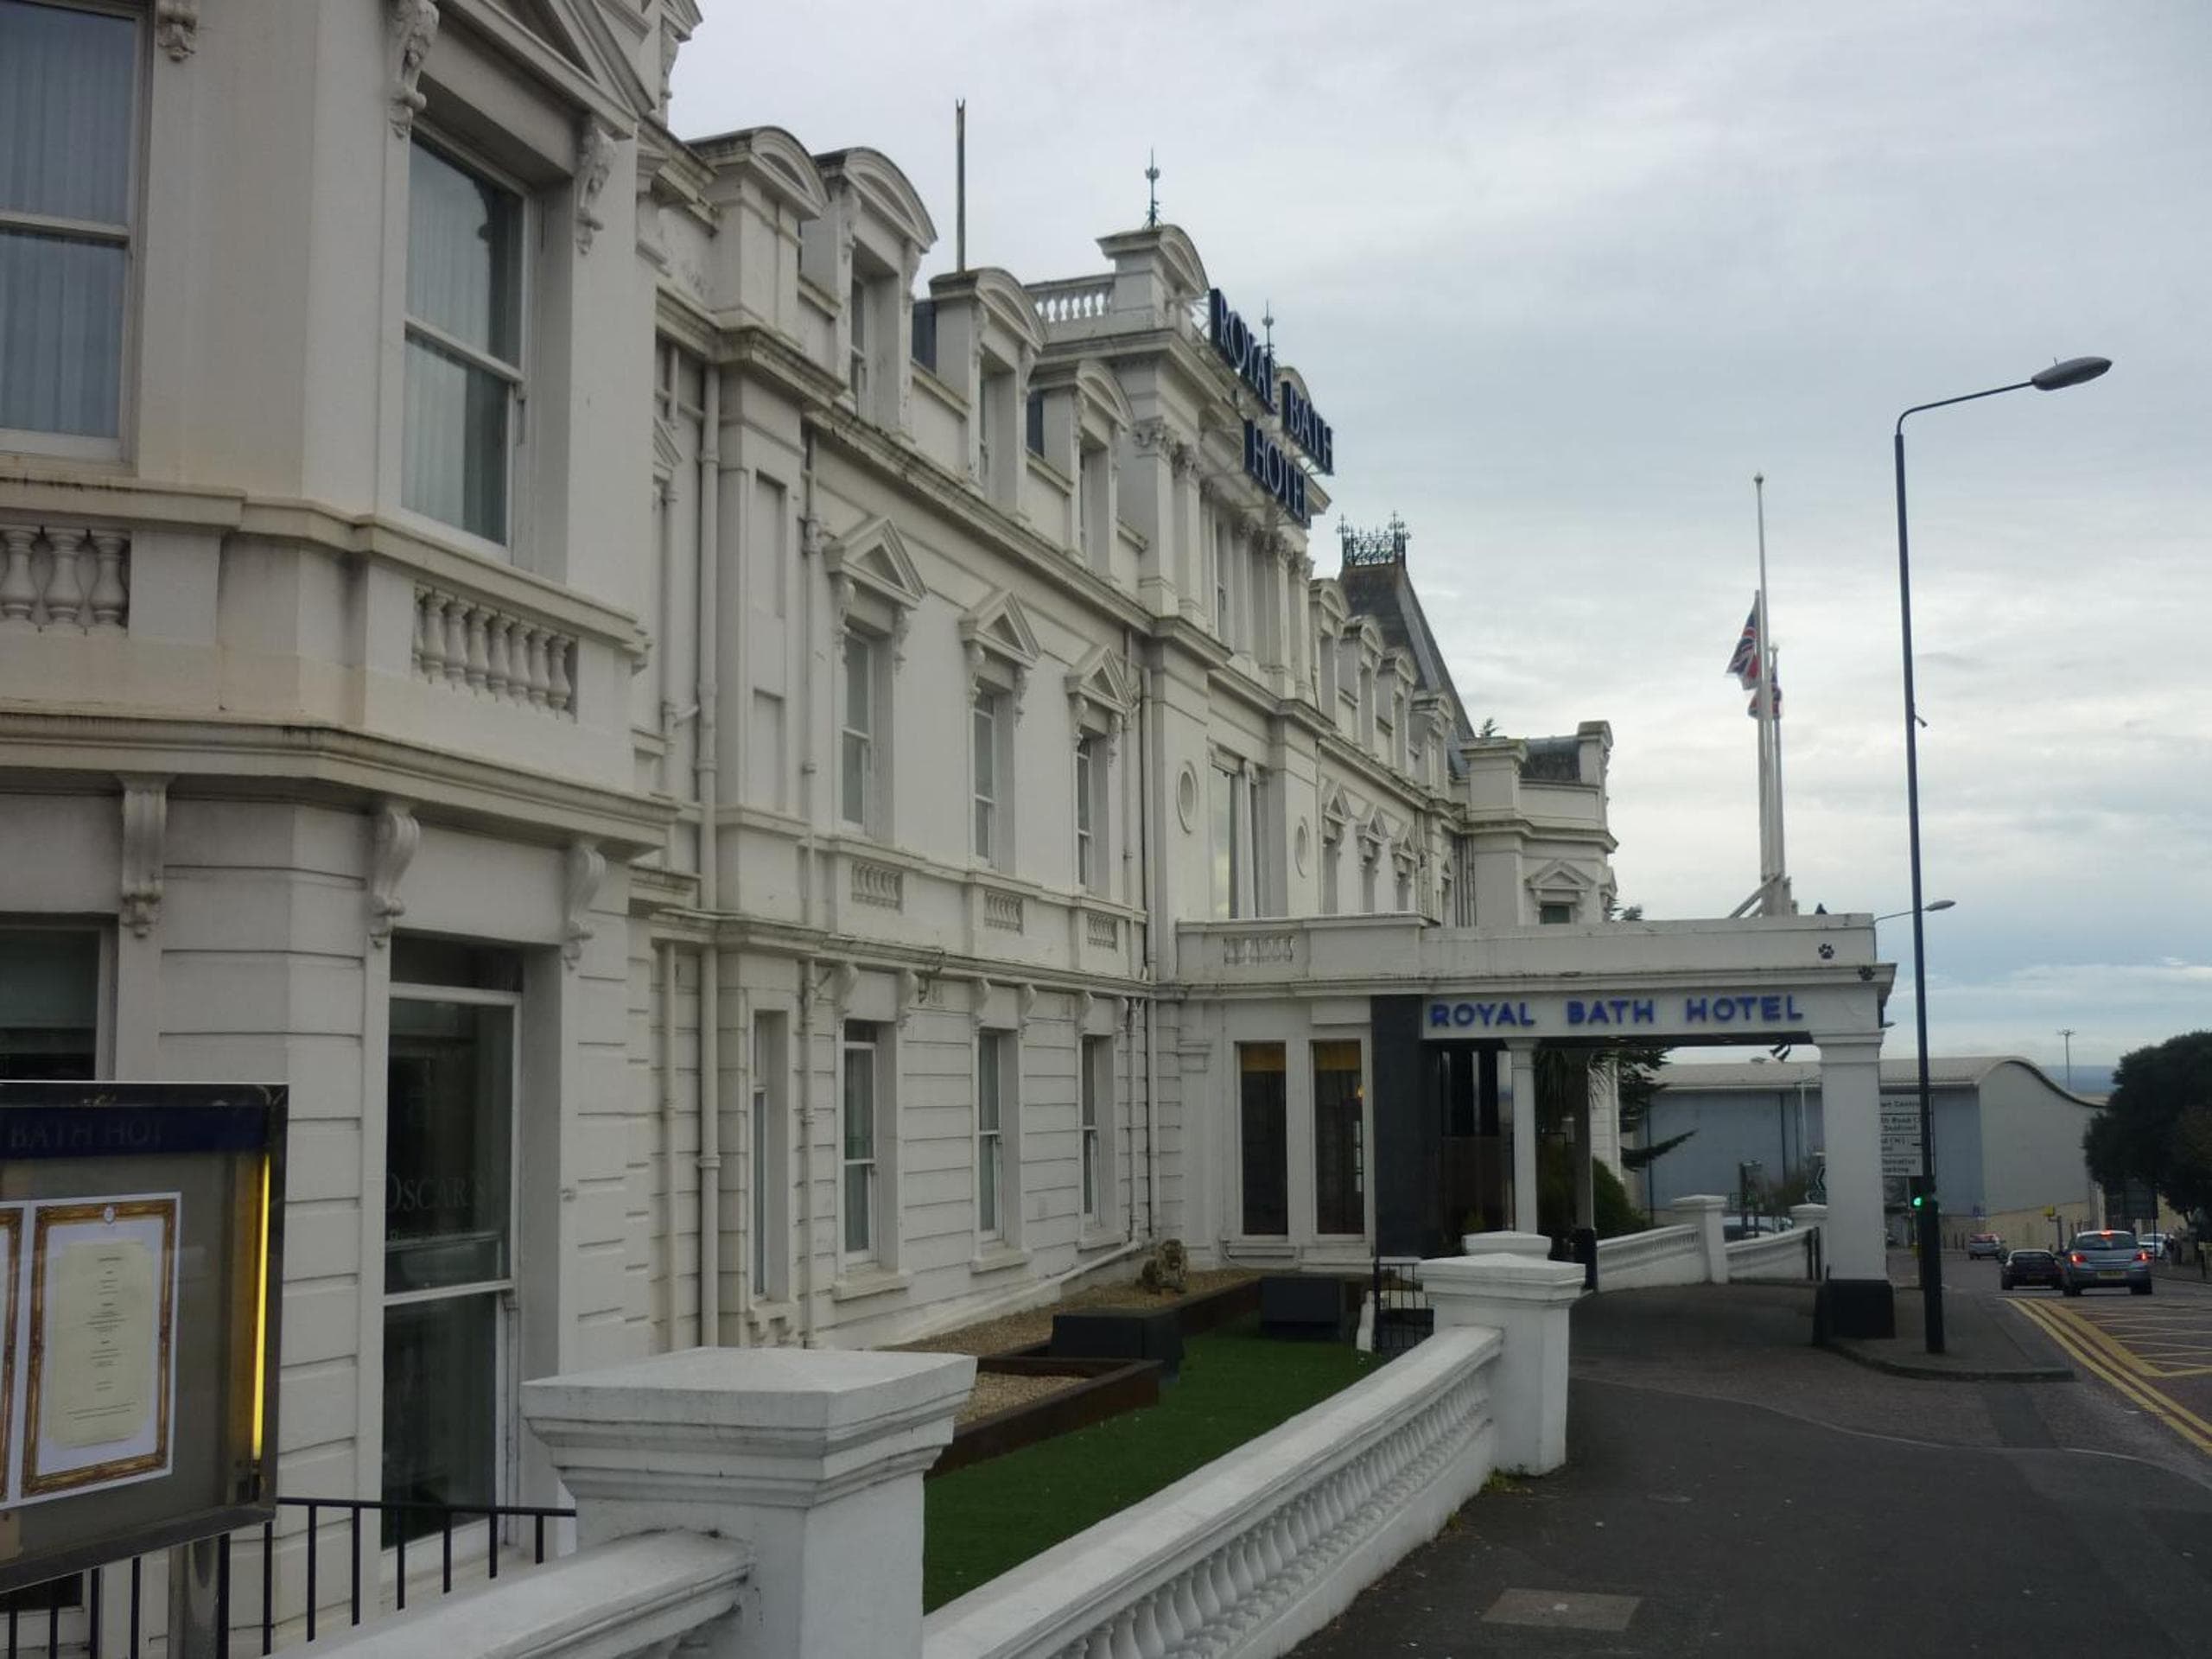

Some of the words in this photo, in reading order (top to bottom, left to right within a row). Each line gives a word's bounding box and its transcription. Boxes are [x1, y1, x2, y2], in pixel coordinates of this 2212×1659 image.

[1210, 288, 1278, 415] ROYAL
[1281, 381, 1334, 476] BATH
[1244, 420, 1312, 529] HOTEL
[1430, 1001, 1536, 1028] ROYAL
[1567, 999, 1655, 1026] BATH
[1686, 995, 1804, 1023] HOTEL
